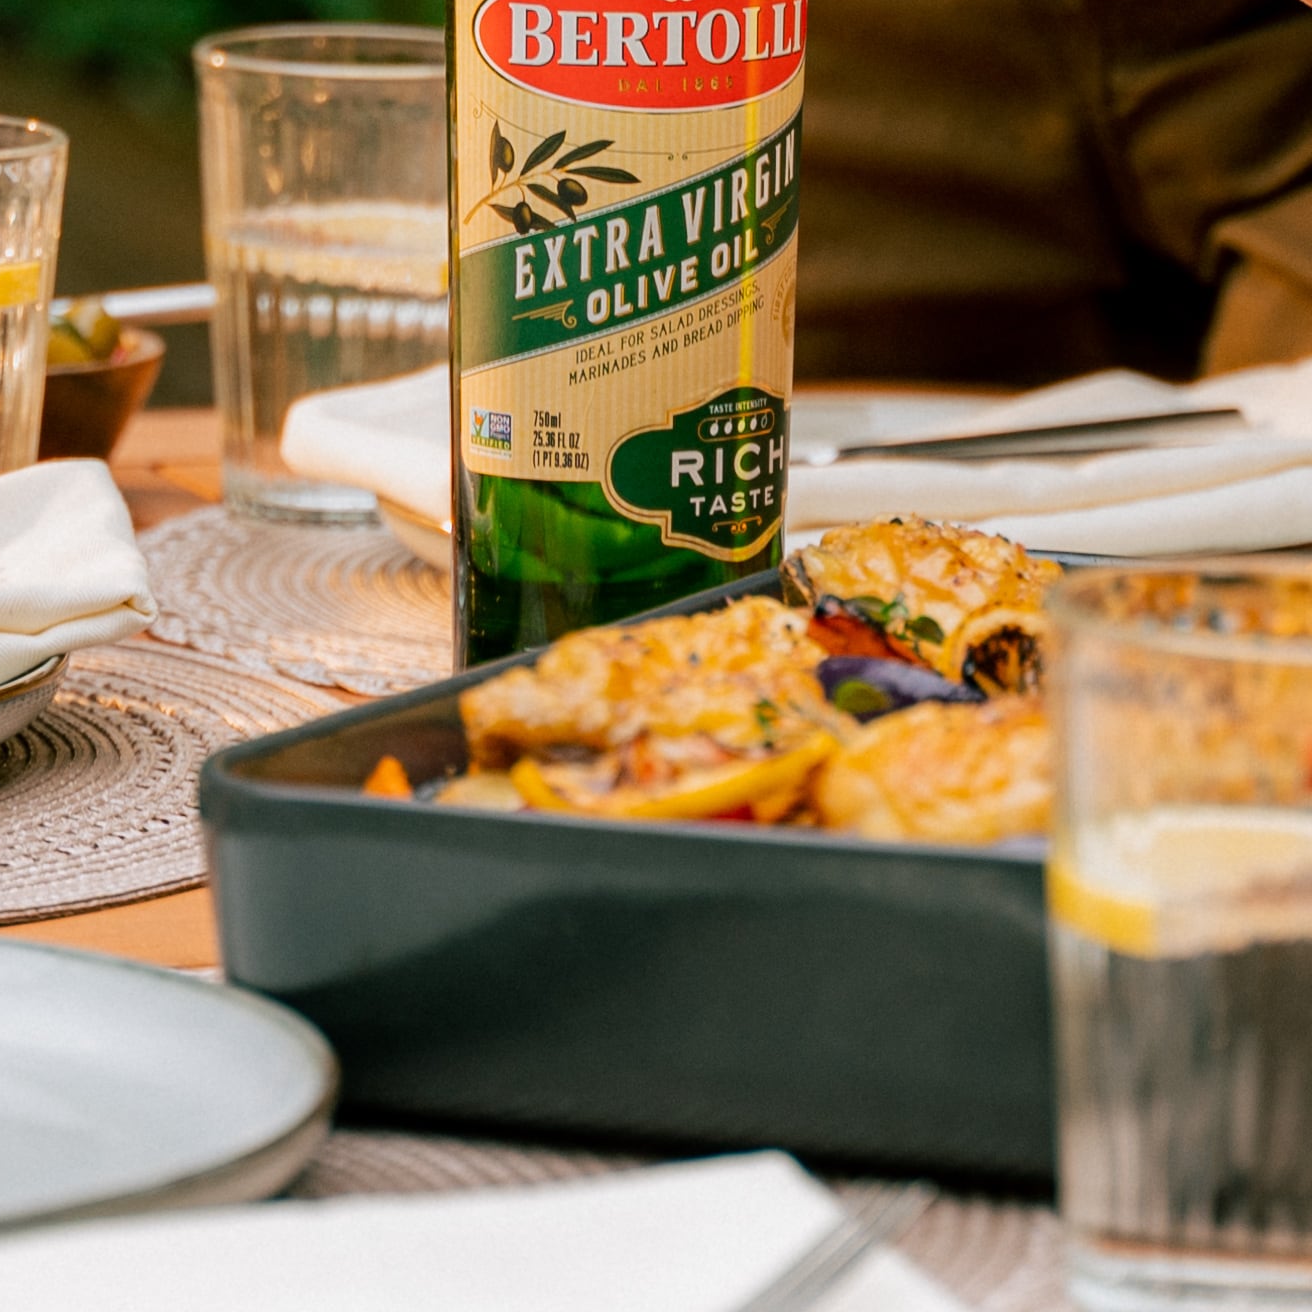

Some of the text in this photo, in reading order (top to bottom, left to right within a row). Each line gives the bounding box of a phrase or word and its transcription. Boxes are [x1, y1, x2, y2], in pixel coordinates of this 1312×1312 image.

[514, 128, 795, 301] EXTRA VIRGIN
[586, 255, 698, 325] OLIVE
[711, 228, 759, 278] OIL
[568, 294, 765, 386] MARINADES AND BREAD DIPPING
[575, 340, 615, 365] IDEAL
[620, 330, 645, 351] FOR
[650, 312, 694, 341] SALAD
[490, 413, 511, 426] NON
[533, 410, 562, 429] 750ml
[709, 397, 768, 415] TASTE INTENSITY
[532, 430, 556, 448] 25.36
[557, 431, 567, 449] FL
[569, 432, 581, 450] OZ
[532, 449, 541, 469] (1
[542, 450, 553, 468] PT
[554, 451, 573, 469] 9.36
[574, 451, 590, 472] OZ)
[671, 434, 784, 488] RICH
[689, 484, 774, 517] TASTE
